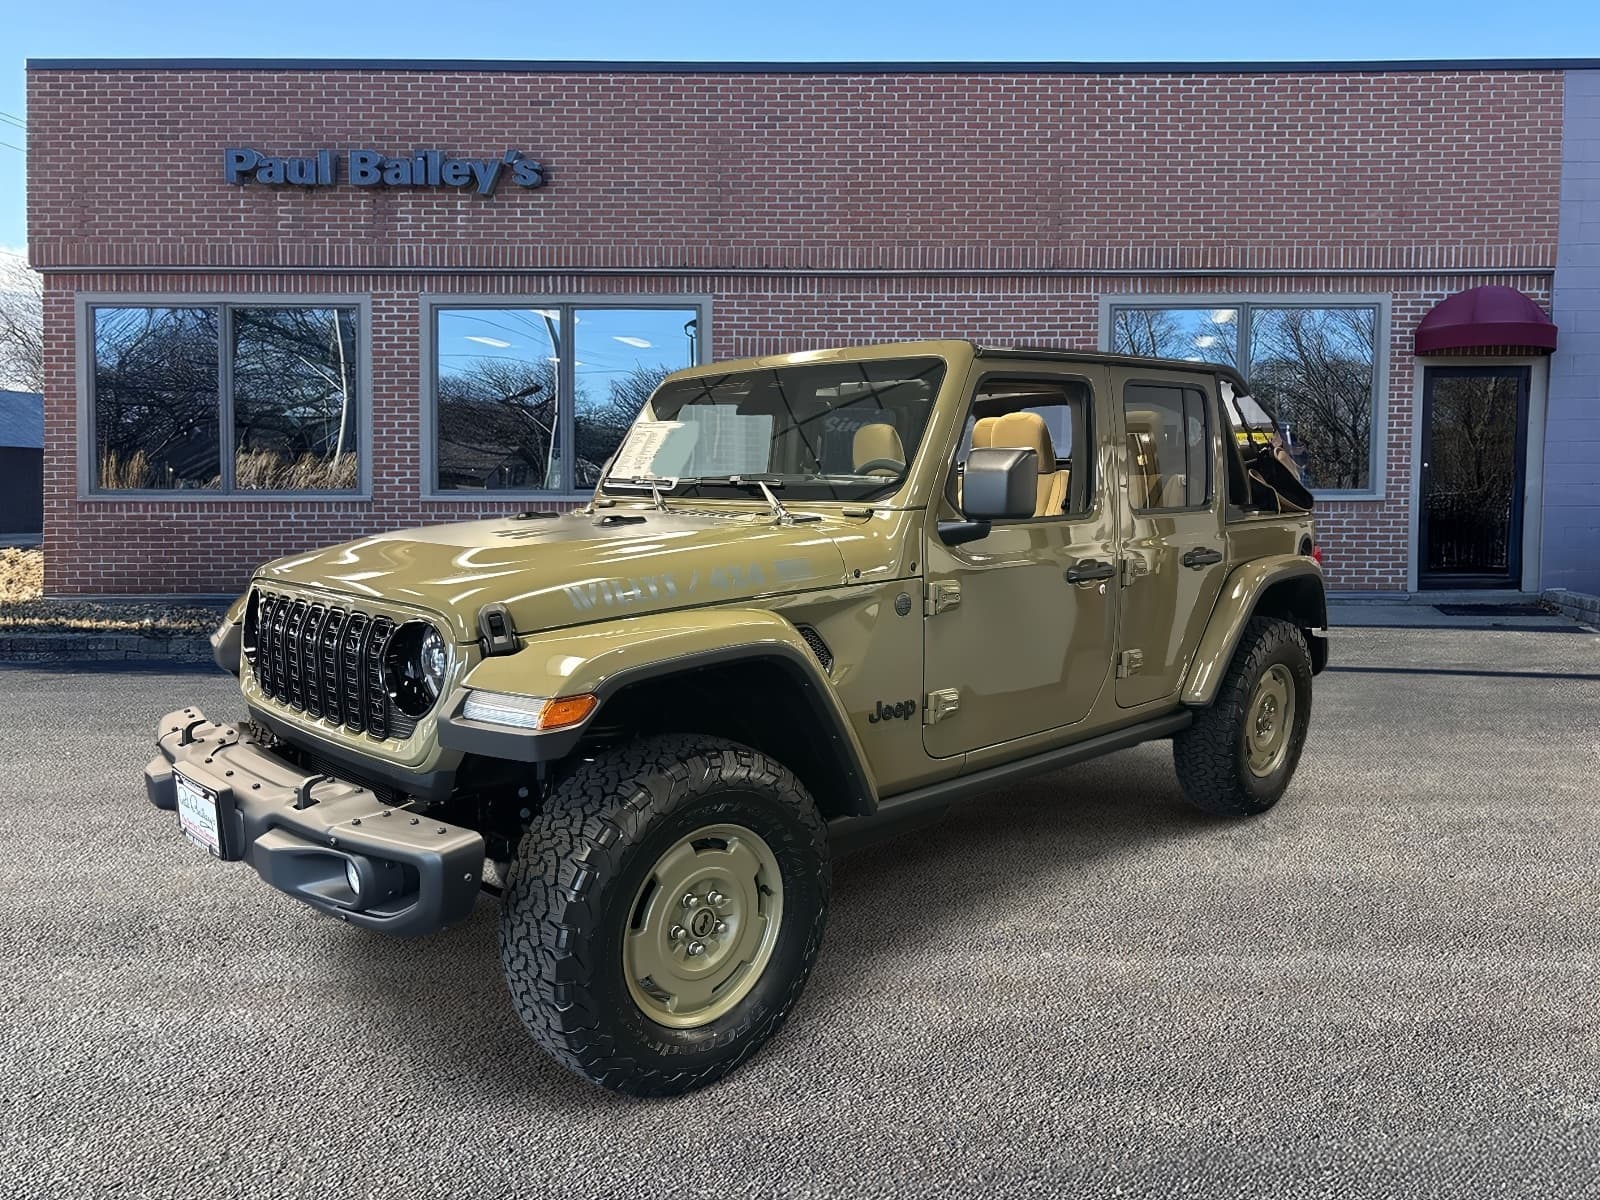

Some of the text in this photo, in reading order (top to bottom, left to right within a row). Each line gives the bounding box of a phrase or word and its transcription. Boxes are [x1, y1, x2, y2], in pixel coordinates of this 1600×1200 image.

[223, 149, 546, 196] Paul Bailey's
[868, 700, 916, 724] Jeep
